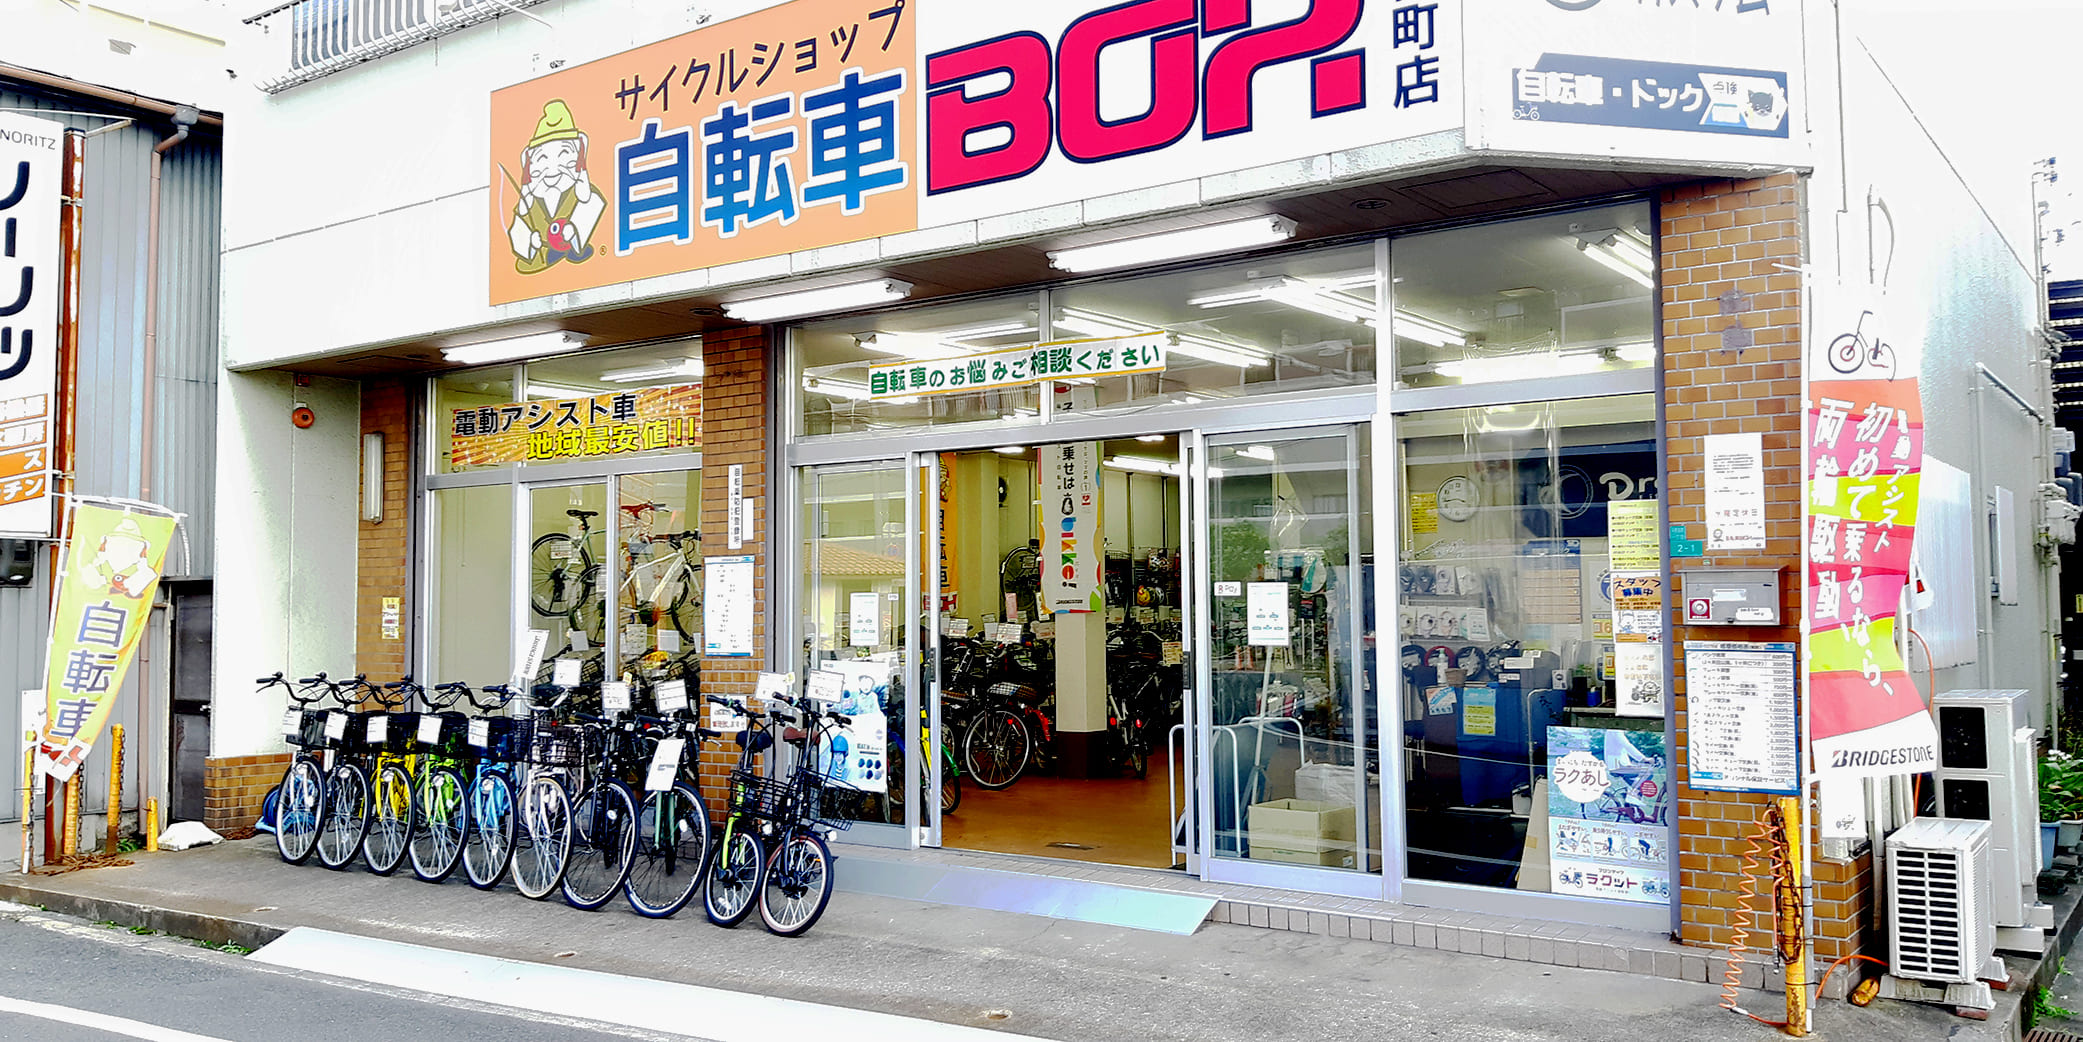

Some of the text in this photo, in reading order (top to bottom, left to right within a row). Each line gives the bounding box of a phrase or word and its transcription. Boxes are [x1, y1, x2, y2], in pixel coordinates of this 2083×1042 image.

[614, 0, 905, 121] サイクルショップ
[926, 0, 1366, 197] BOX
[0, 128, 56, 150] NORITZ
[616, 70, 905, 255] 自転車
[455, 392, 638, 436] 電動アシスト車
[1676, 544, 1695, 553] 2-1
[50, 599, 129, 738] 自転車
[1831, 746, 1935, 768] BRIDGESTONE
[1554, 767, 1610, 787] ラクあし
[1586, 873, 1638, 889] ラクット
